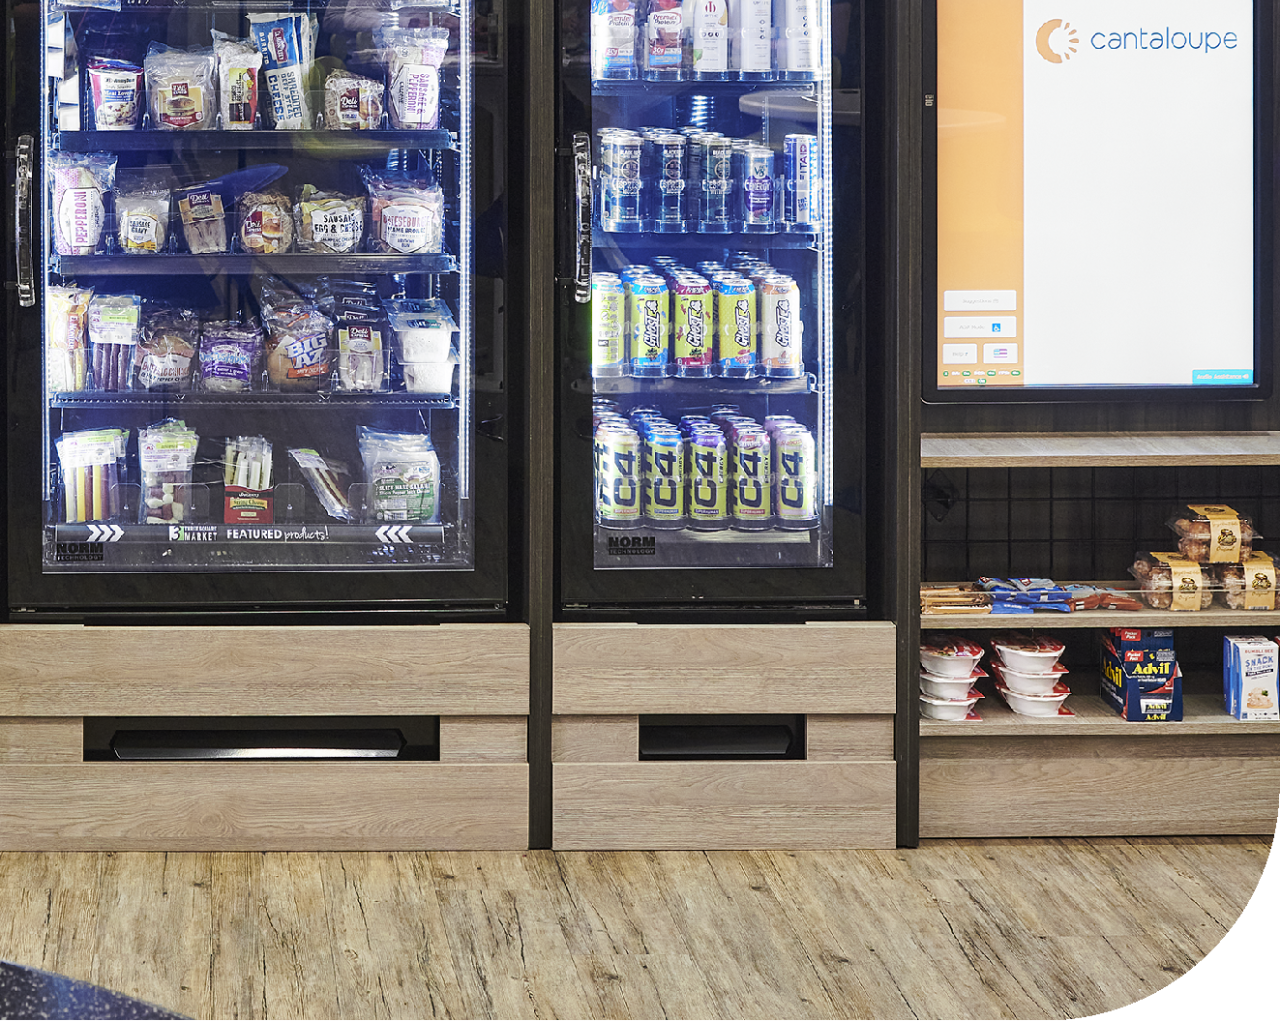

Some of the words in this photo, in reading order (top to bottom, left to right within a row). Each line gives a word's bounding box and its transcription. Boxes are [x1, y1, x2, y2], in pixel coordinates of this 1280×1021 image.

[1091, 27, 1238, 53] cantaloupe
[268, 74, 285, 121] CHEESE
[75, 191, 87, 243] PEPPERONI
[286, 333, 328, 357] BIG
[643, 309, 660, 348] GHOST
[687, 308, 704, 347] GHOST
[734, 307, 750, 347] GHOST
[775, 307, 792, 347] GHOST
[293, 348, 324, 369] AZ
[613, 451, 636, 507] C4
[654, 451, 677, 507] C4
[695, 451, 717, 507] C4
[739, 451, 762, 507] C4
[781, 451, 804, 508] C4
[57, 543, 103, 553] NORM
[184, 533, 217, 541] MARKET
[226, 529, 282, 540] FEATURED
[609, 536, 655, 547] NORM
[1102, 657, 1122, 688] Advil
[1132, 662, 1171, 675] Advil
[1245, 656, 1274, 667] SNACK
